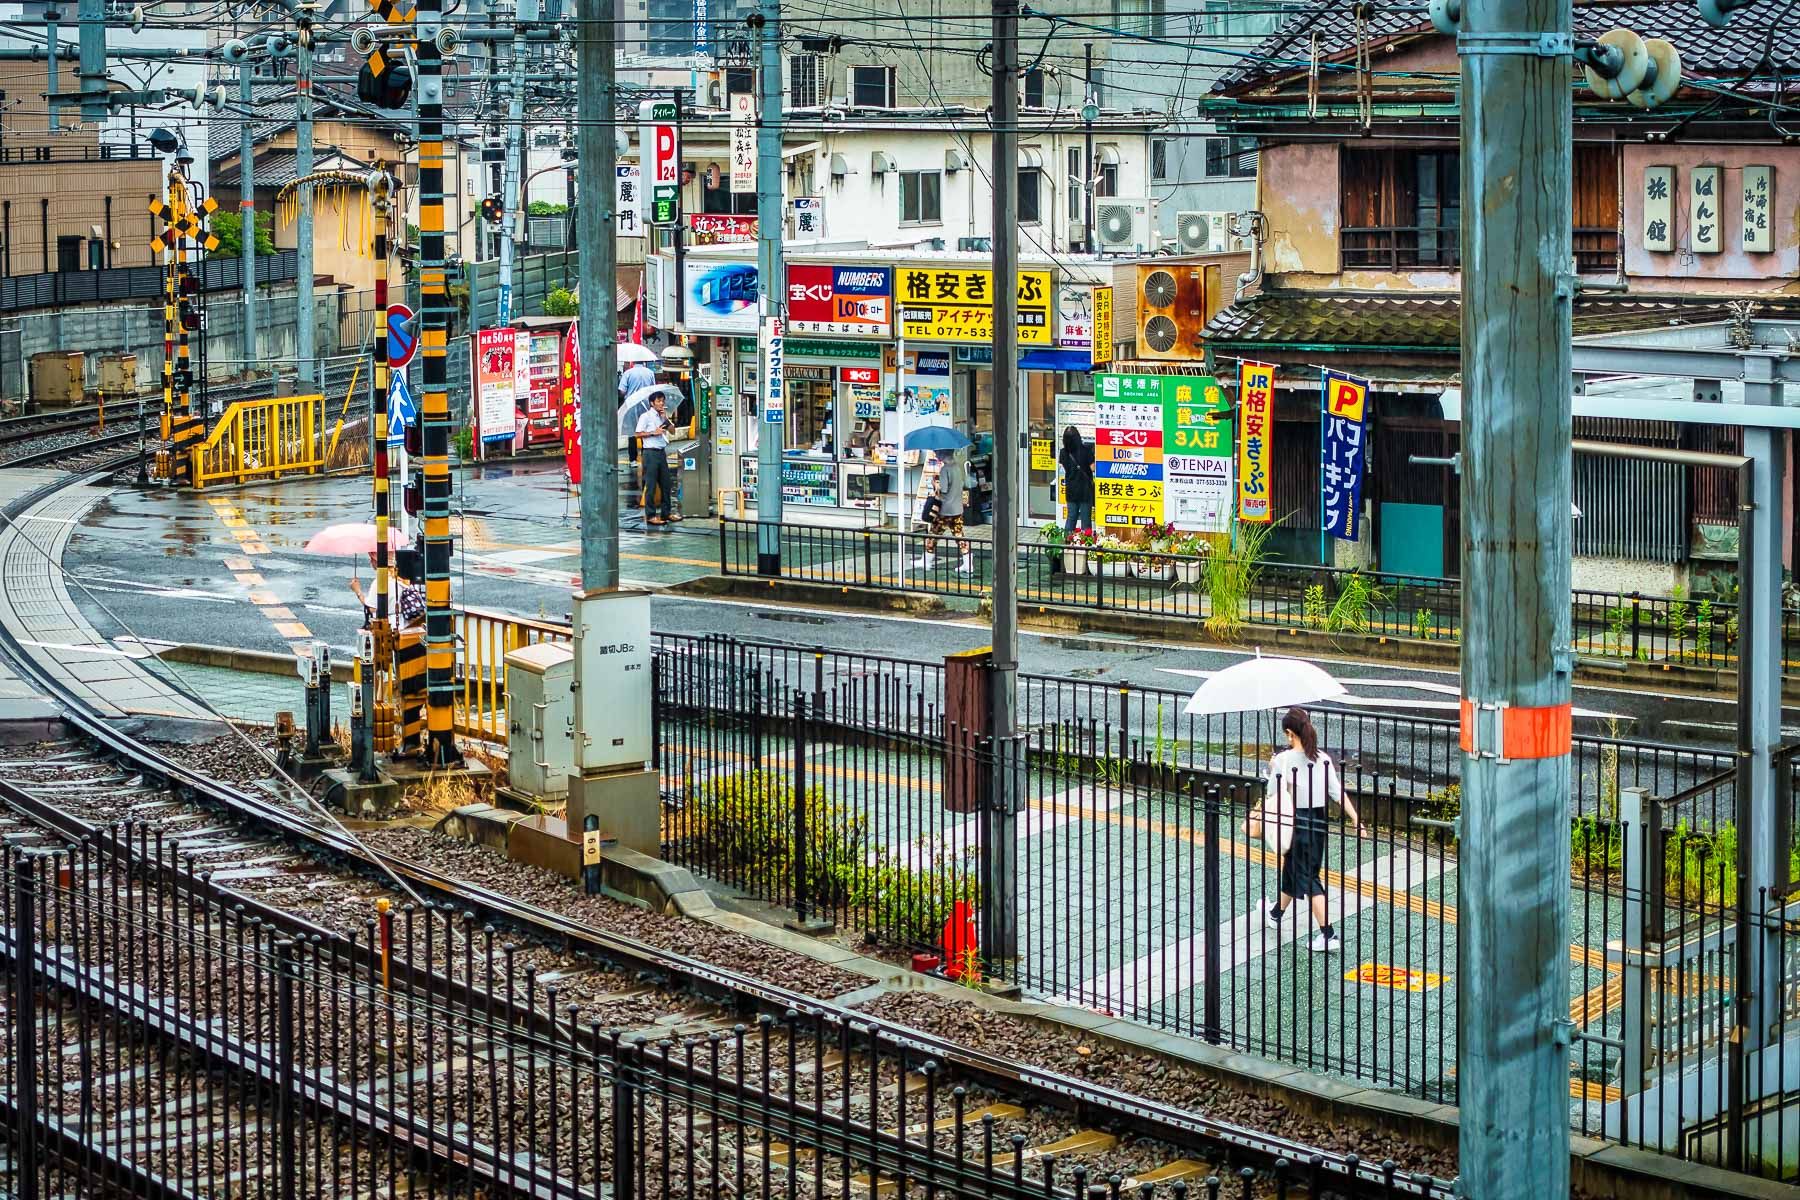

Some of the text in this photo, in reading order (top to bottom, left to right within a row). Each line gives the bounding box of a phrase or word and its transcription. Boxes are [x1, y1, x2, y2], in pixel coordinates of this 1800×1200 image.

[654, 108, 676, 117] アイパーク
[656, 125, 675, 181] P
[664, 167, 676, 180] 24
[620, 181, 634, 231] 麗門
[657, 201, 670, 221] 空
[1646, 177, 1668, 241] 旅館
[1695, 174, 1714, 244] ばんど
[695, 216, 739, 234] 近江牛
[798, 212, 814, 232] 麗
[837, 271, 885, 287] NUMBERS
[906, 271, 1042, 302] 格安きぷ
[789, 283, 833, 302] 宝くじ
[838, 298, 866, 318] LOTO
[797, 321, 881, 335] 今村たばこ店
[907, 325, 932, 336] TEL
[918, 358, 949, 369] NUMBERS
[1334, 384, 1359, 412] P
[855, 402, 872, 416] 29
[1109, 430, 1148, 446] 宝くじ
[1113, 447, 1132, 460] LOTO
[1344, 424, 1361, 489] コイン
[1109, 462, 1149, 476] NUMBERS
[1181, 458, 1227, 473] TENPAI
[1325, 417, 1346, 531] パーキング
[1098, 481, 1162, 498] 格安きっぷ
[1104, 502, 1155, 514] アイチケット
[1244, 498, 1267, 509] 販売中
